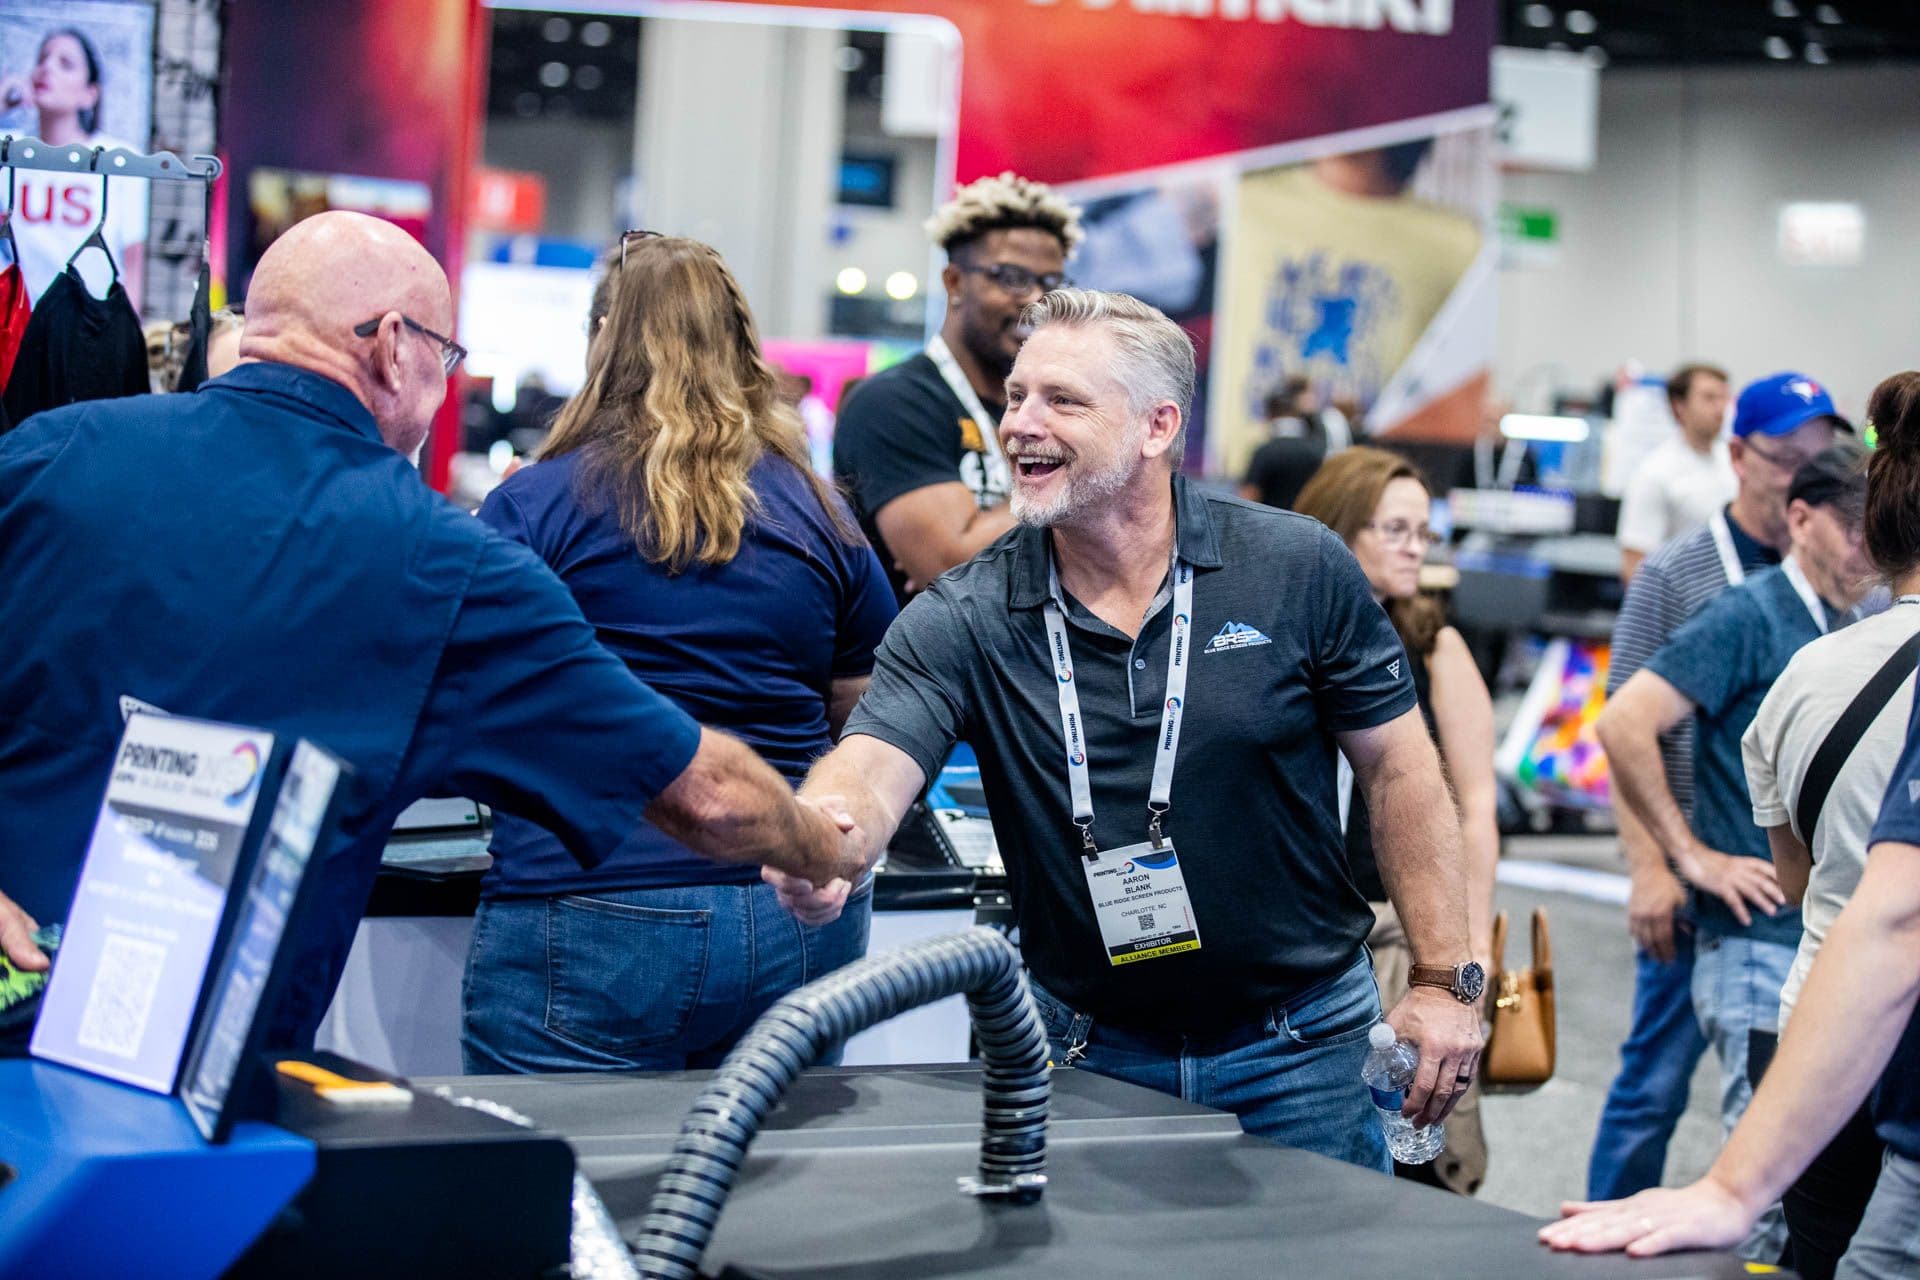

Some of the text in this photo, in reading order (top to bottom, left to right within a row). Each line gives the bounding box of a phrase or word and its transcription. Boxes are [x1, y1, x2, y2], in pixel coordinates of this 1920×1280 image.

[22, 184, 91, 226] us
[1055, 632, 1065, 662] PRINTING
[1213, 630, 1260, 648] BRSP
[1175, 636, 1183, 666] PRINTING
[1068, 713, 1077, 743] PRINTING
[1164, 720, 1174, 750] PRINTING
[120, 742, 198, 777] PRINTING
[1093, 868, 1118, 878] PRINTING
[1123, 873, 1150, 885] AARON
[1098, 886, 1183, 908] BLUE RIDGE SCREEN PRODUCTS
[1125, 883, 1152, 894] BLANK
[1120, 943, 1192, 963] ALLIANCE MEMBER
[1134, 937, 1172, 950] EXHIBITOR
